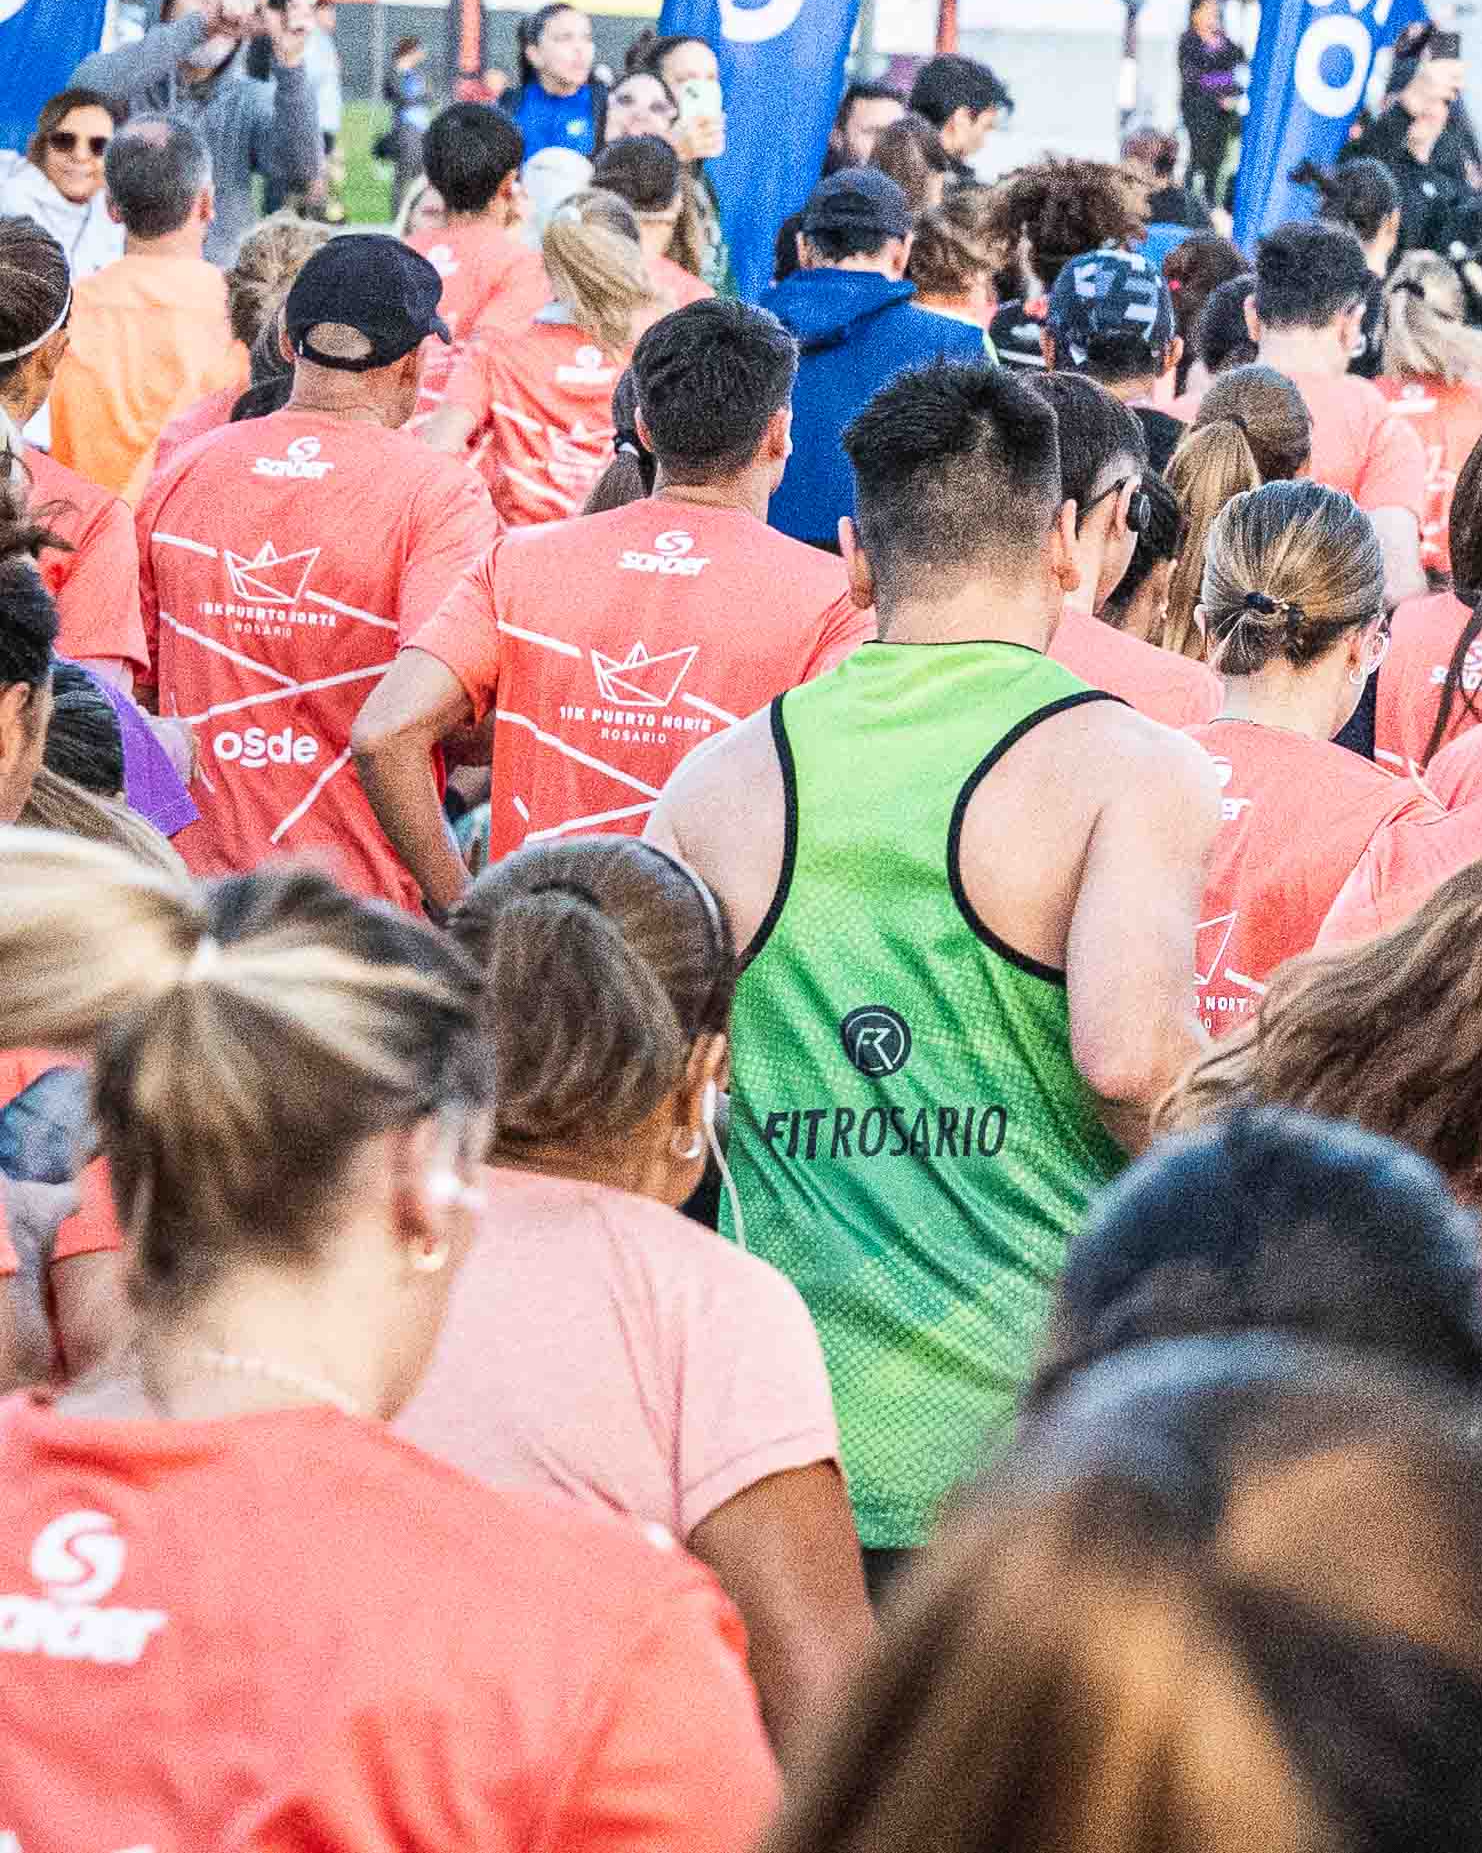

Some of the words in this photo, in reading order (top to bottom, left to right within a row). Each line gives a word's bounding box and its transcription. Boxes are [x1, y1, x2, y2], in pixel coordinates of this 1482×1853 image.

[591, 709, 656, 728] PUERTO
[601, 728, 667, 744] ROSARIO
[213, 727, 319, 768] osde
[1205, 995, 1250, 1013] NORT
